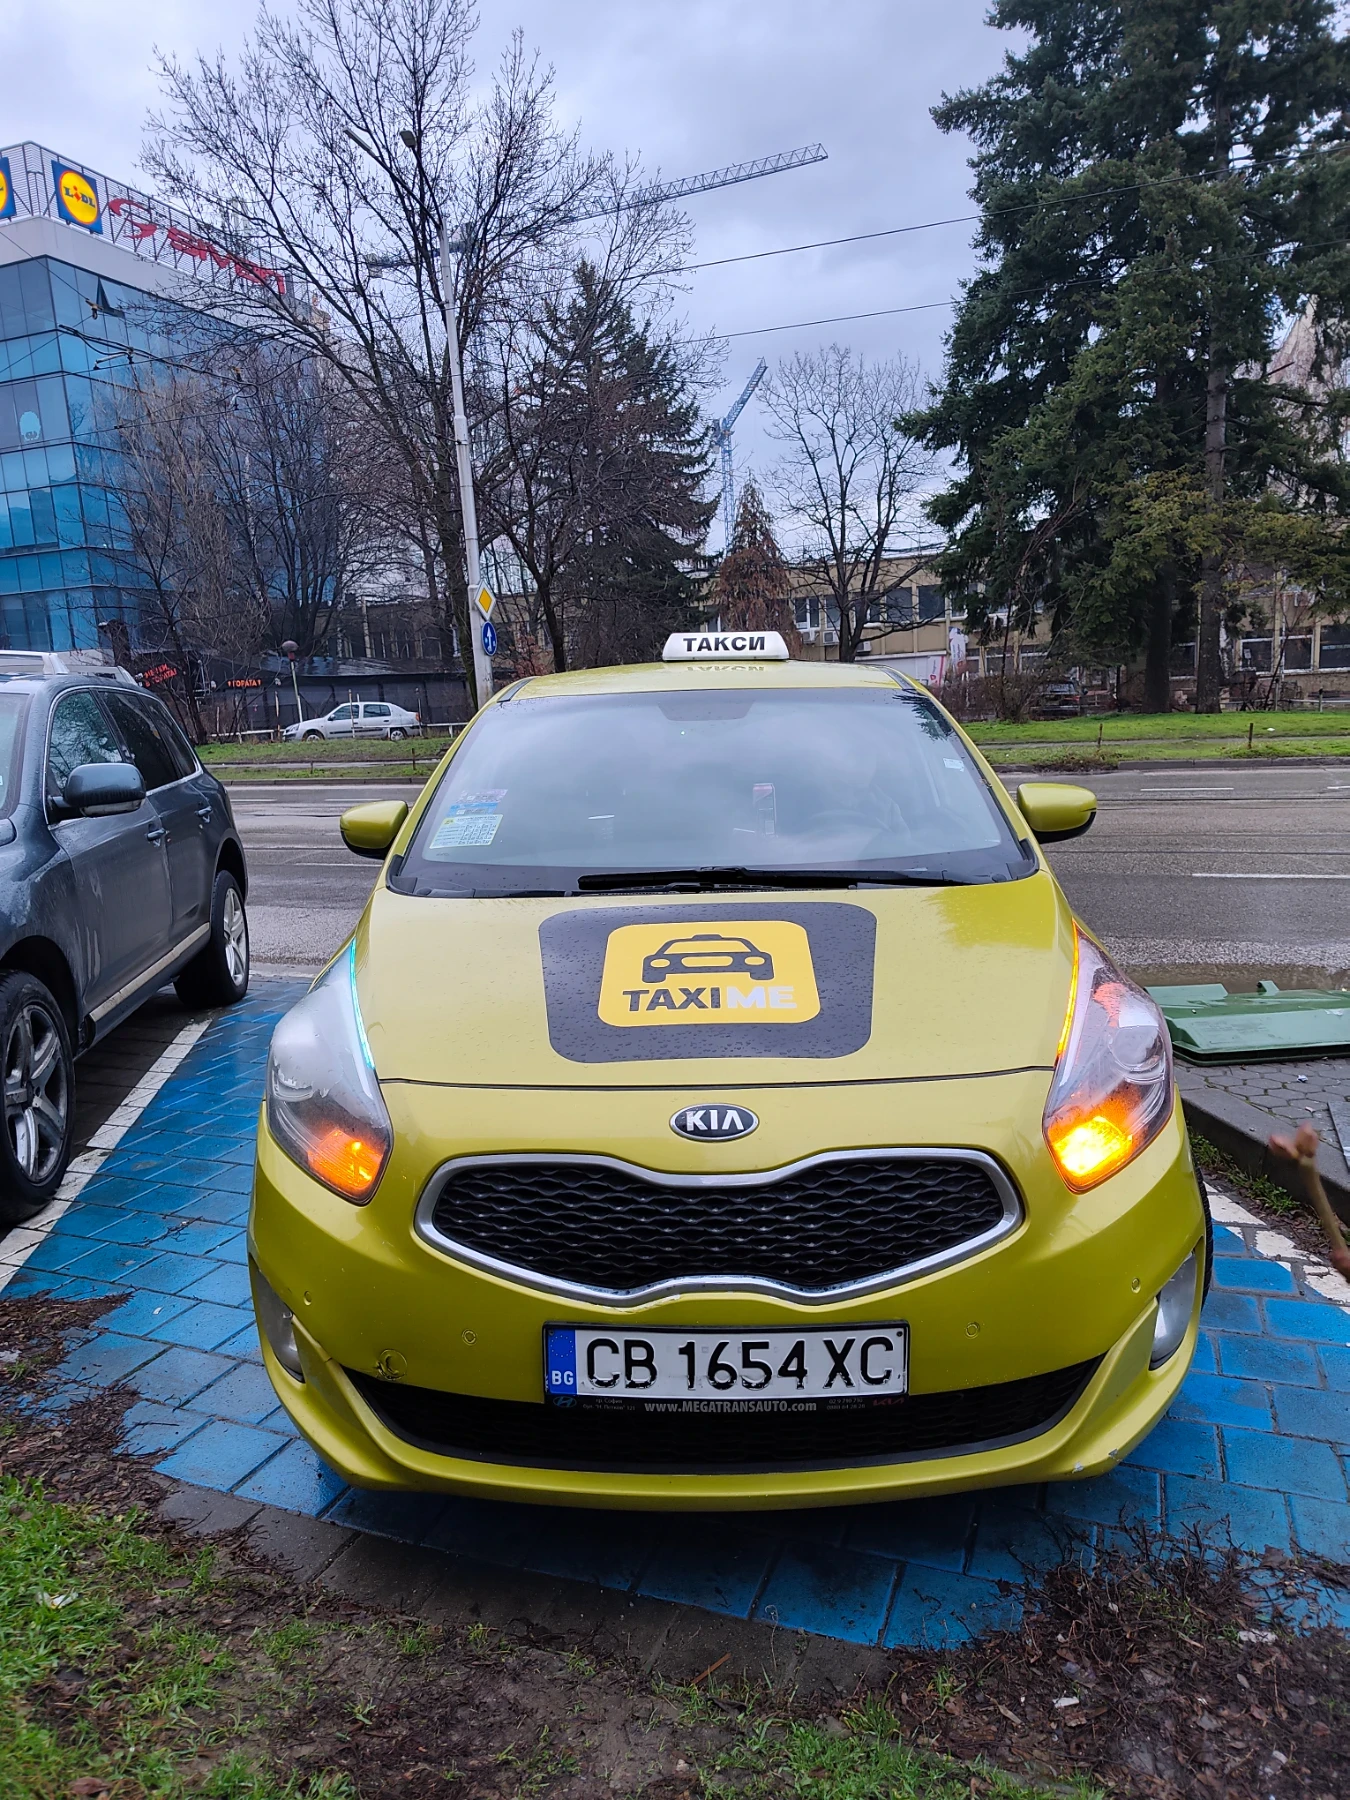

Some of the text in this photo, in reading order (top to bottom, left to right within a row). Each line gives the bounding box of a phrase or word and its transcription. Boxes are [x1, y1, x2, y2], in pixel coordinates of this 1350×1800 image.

[683, 636, 765, 652] ТАКСИ
[685, 1109, 745, 1131] KIA
[678, 1340, 808, 1391] 1654
[551, 1370, 574, 1386] BG
[645, 1401, 817, 1413] www.MEGATRANSAUTO.com
